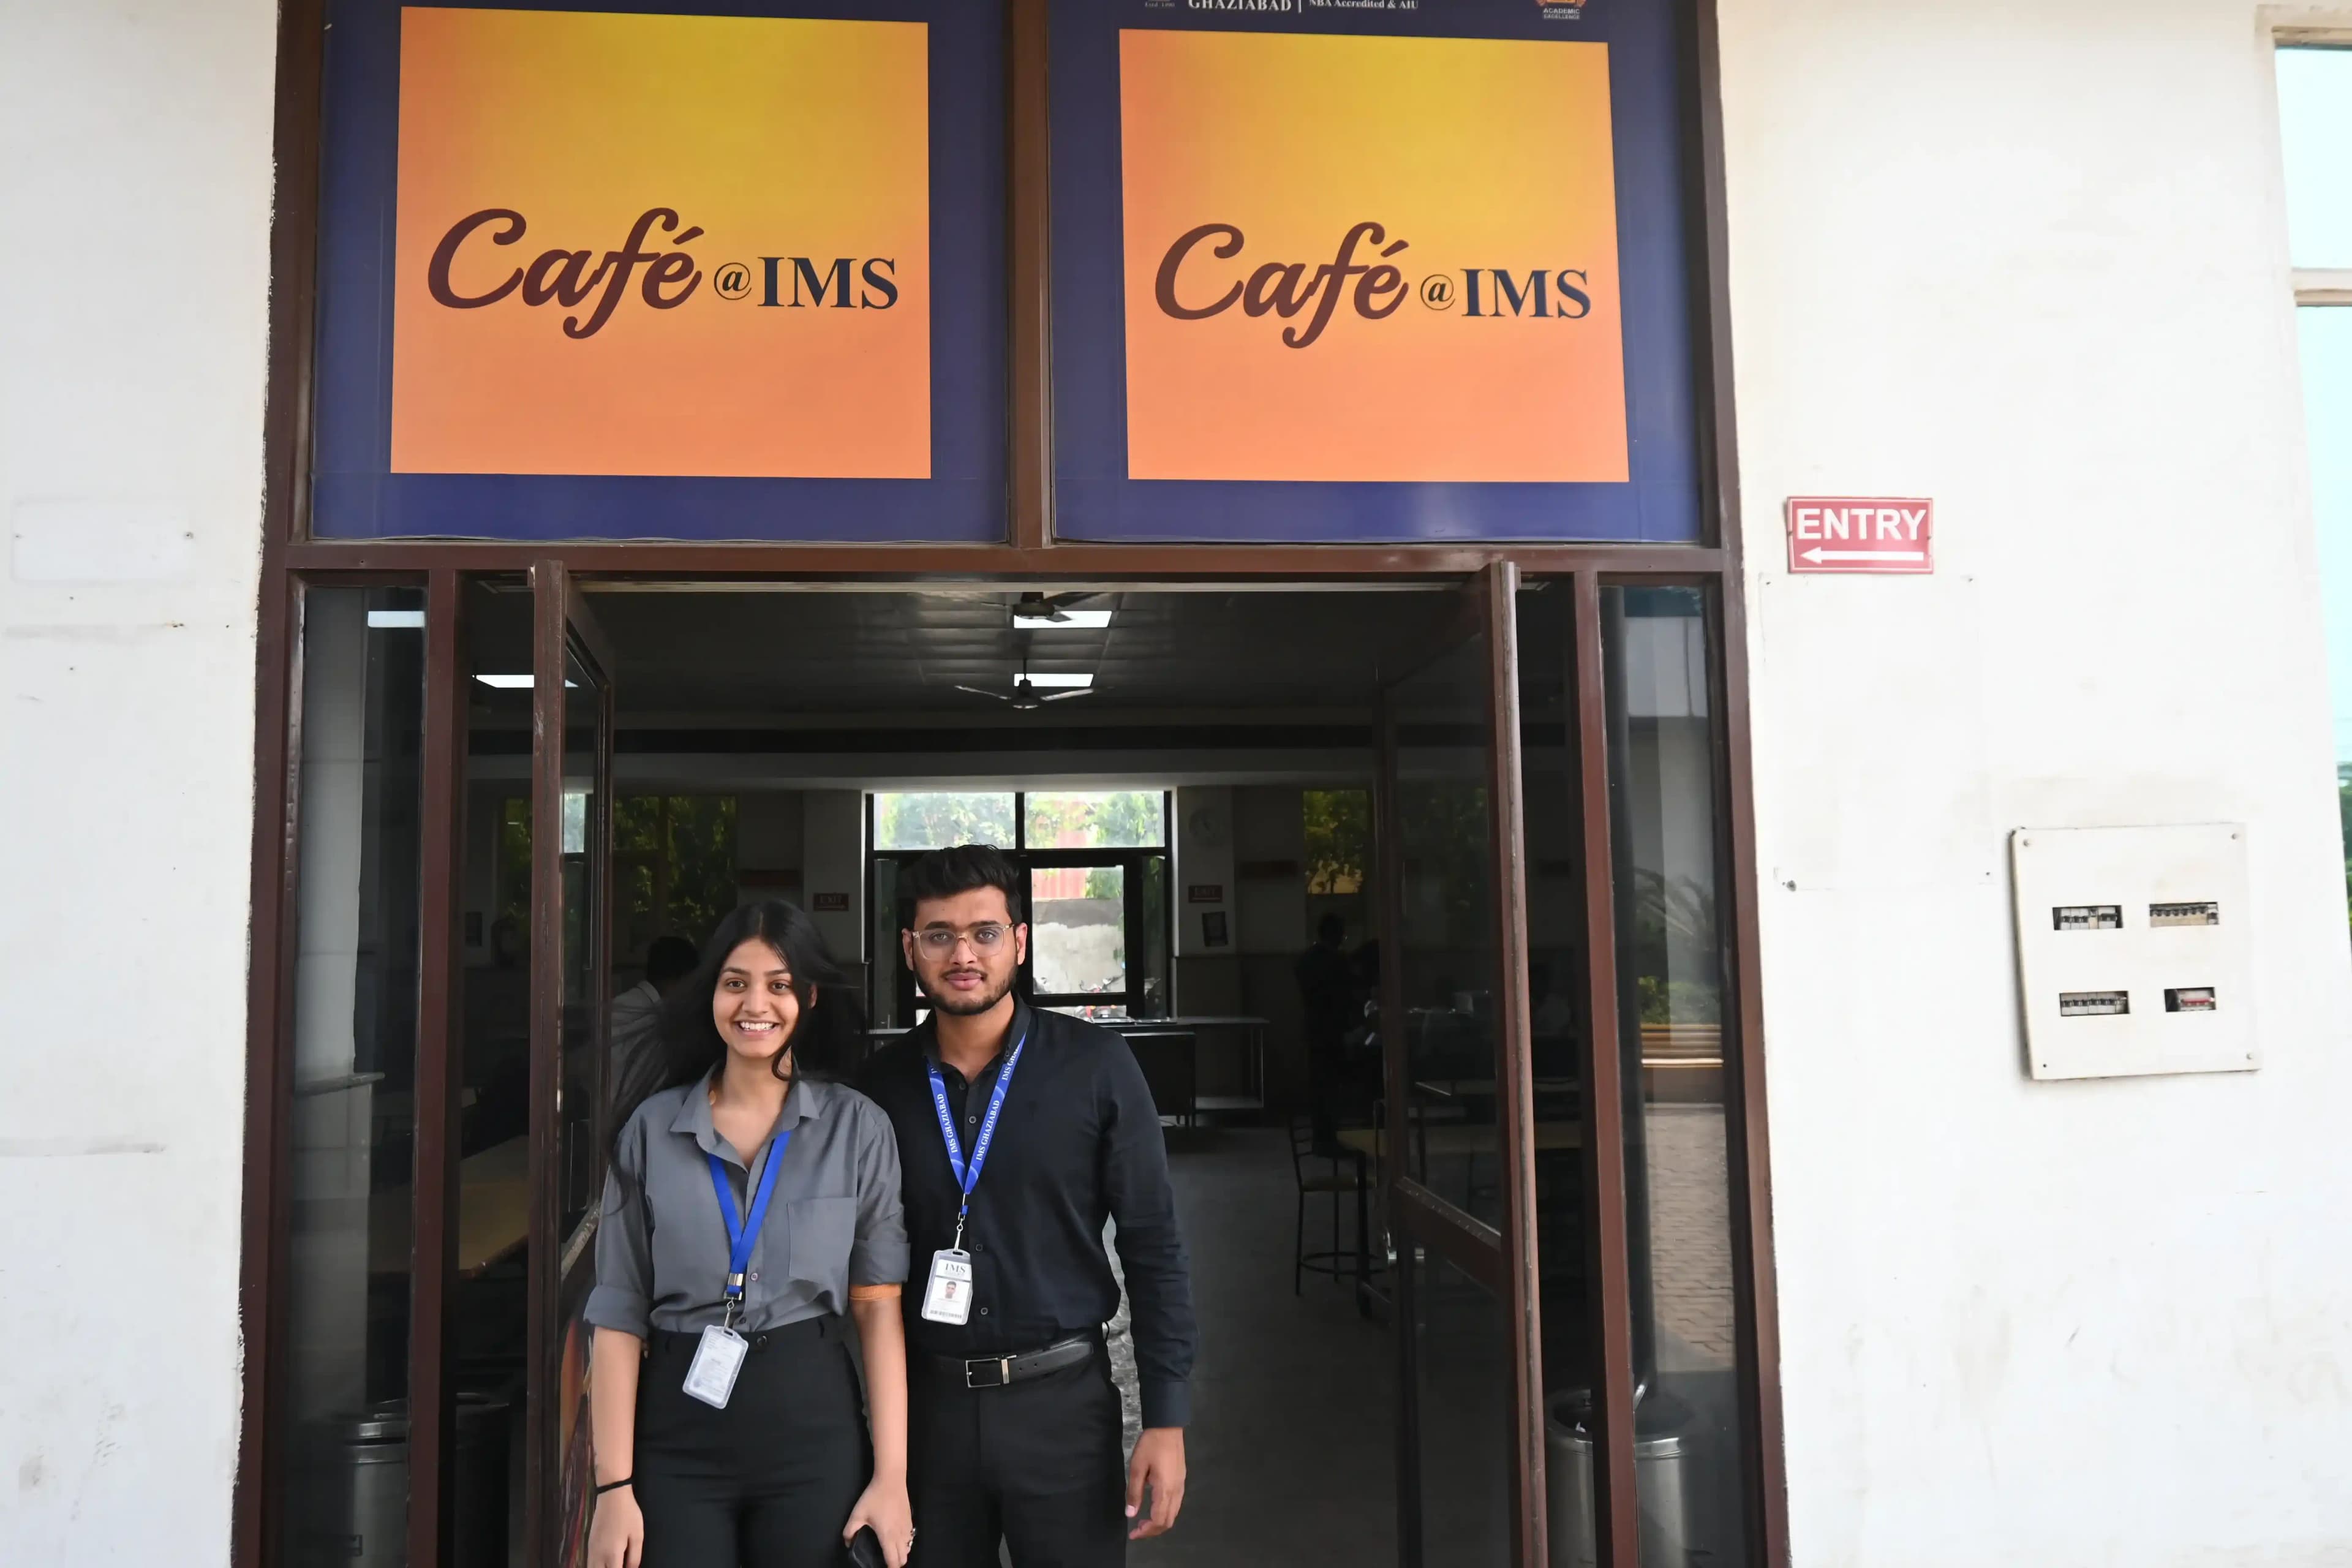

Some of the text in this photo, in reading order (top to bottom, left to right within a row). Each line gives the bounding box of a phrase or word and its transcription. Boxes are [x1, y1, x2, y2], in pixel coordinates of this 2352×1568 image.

[1387, 0, 1396, 9] &
[426, 206, 705, 339] Café
[1155, 221, 1410, 349] Café
[1796, 508, 1927, 540] ENTRY
[1001, 1066, 1012, 1082] IMS
[937, 1093, 959, 1153] IMS GHAZIABAD
[975, 1099, 1000, 1161] IMS GHAZIABAD
[945, 1263, 966, 1273] IMS
